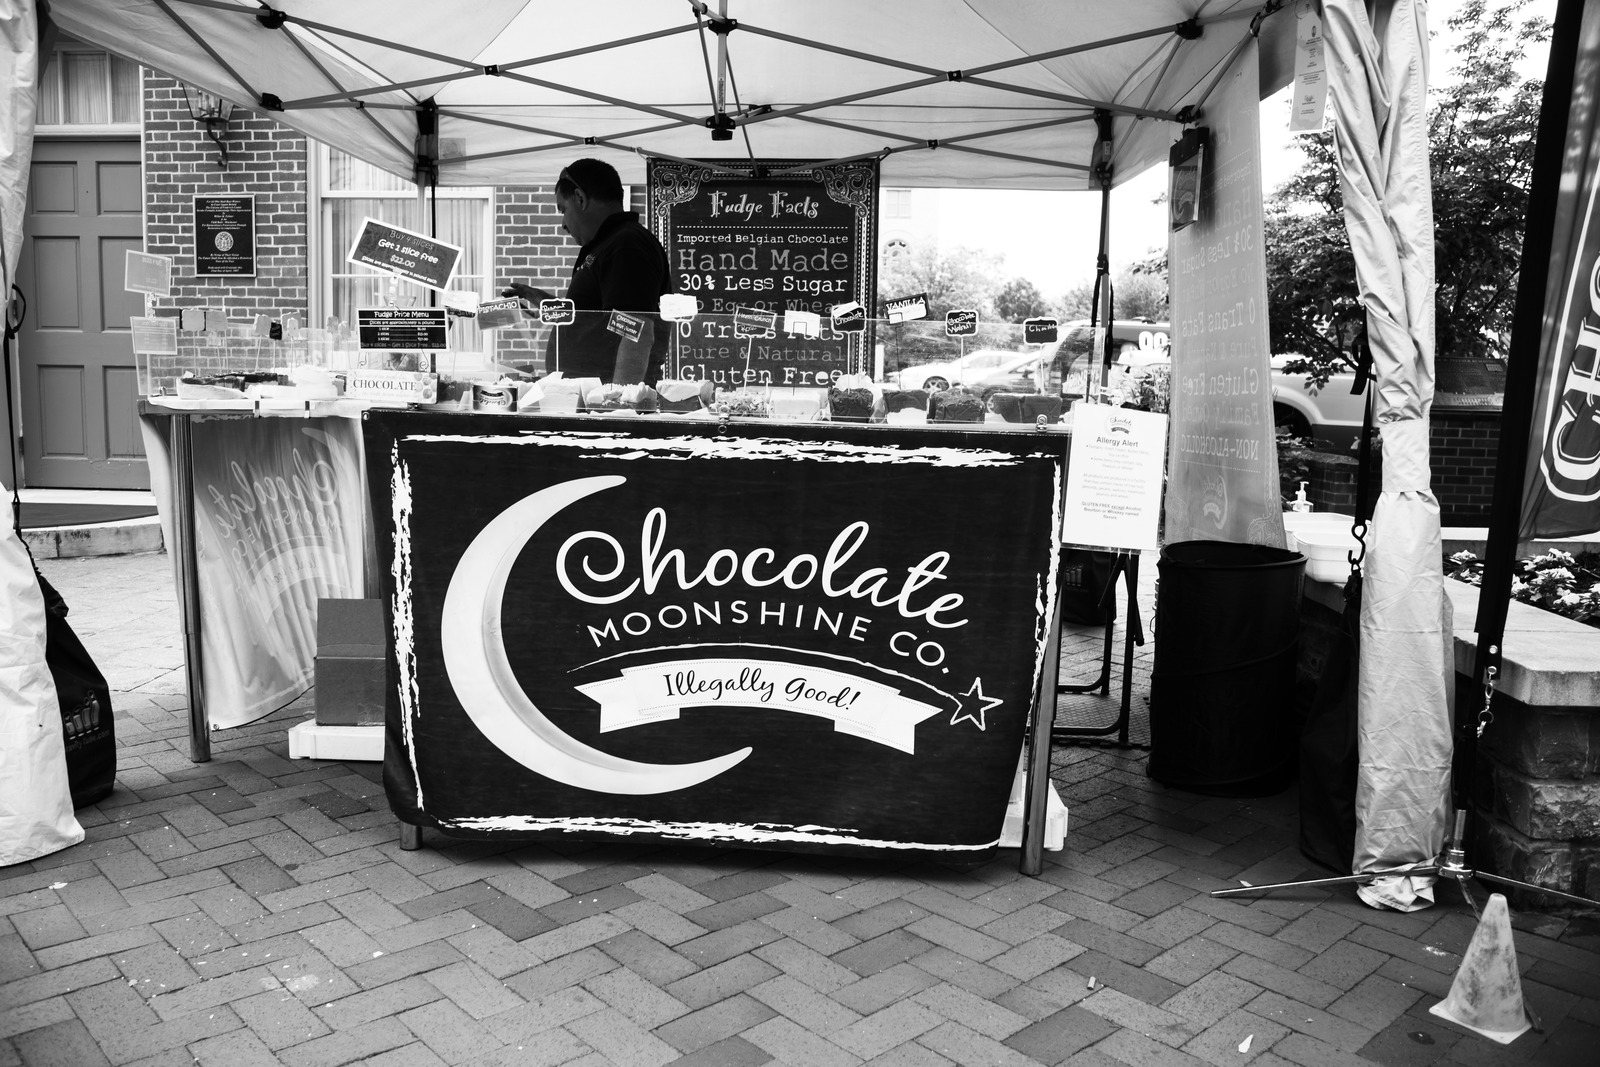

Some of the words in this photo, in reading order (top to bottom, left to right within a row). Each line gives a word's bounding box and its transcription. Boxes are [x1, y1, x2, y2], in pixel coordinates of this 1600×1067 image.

[708, 190, 763, 221] Fudge
[769, 190, 819, 219] Facts
[677, 234, 731, 245] Imported
[735, 234, 784, 245] Belgian
[788, 234, 848, 244] Chocolate
[378, 239, 394, 249] Get
[401, 246, 420, 258] slice
[420, 253, 438, 264] free
[390, 254, 415, 268] $22.00
[678, 248, 758, 272] Hand
[771, 248, 848, 272] Made
[679, 273, 715, 291] 30%
[725, 275, 774, 291] Less
[783, 276, 847, 296] Sugar
[478, 301, 517, 314] PISTACHIO
[680, 345, 730, 361] Pure
[739, 346, 749, 360] &
[758, 345, 846, 362] Natural
[353, 379, 417, 390] CHOCOLATE
[680, 364, 776, 385] Gluten
[783, 367, 844, 385] Free
[1096, 436, 1120, 447] Allergy
[1122, 439, 1138, 447] Alert
[555, 507, 969, 629] Chocolate
[586, 600, 873, 648] MOONSHINE
[889, 631, 950, 674] CO.
[662, 668, 775, 702] Illegally
[784, 676, 861, 711] Good!
